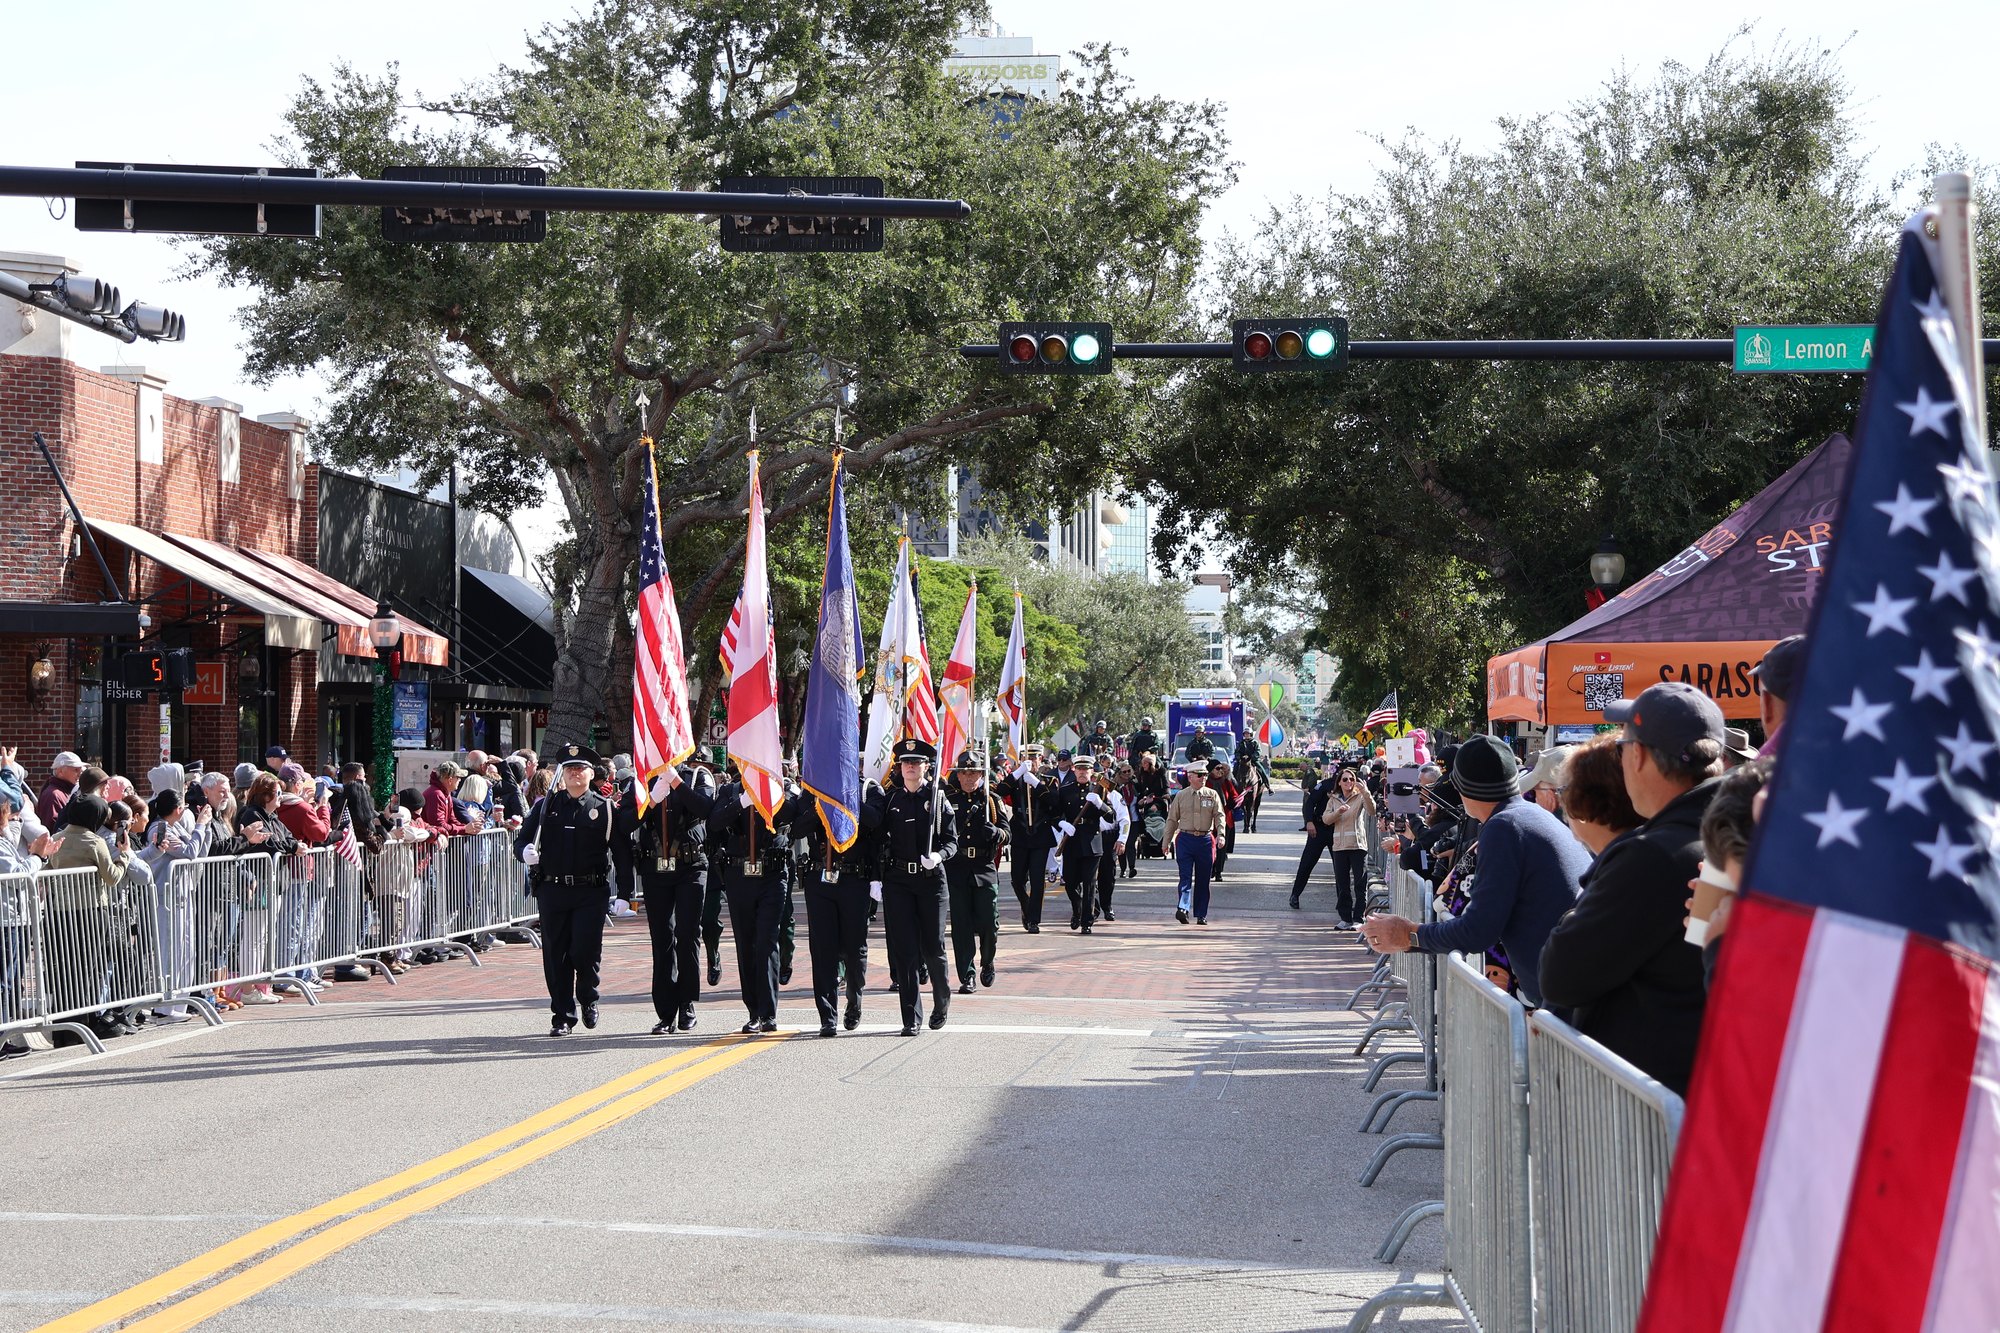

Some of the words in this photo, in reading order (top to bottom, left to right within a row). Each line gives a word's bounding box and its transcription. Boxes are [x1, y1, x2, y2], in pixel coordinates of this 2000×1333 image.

[942, 64, 1048, 80] DVISORS
[1785, 339, 1847, 359] Lemon
[151, 658, 163, 681] 5
[1608, 662, 1635, 672] LISTEN!
[106, 680, 126, 689] EIL
[106, 689, 142, 699] FISHER
[1185, 720, 1227, 728] POLICE
[717, 727, 724, 737] P
